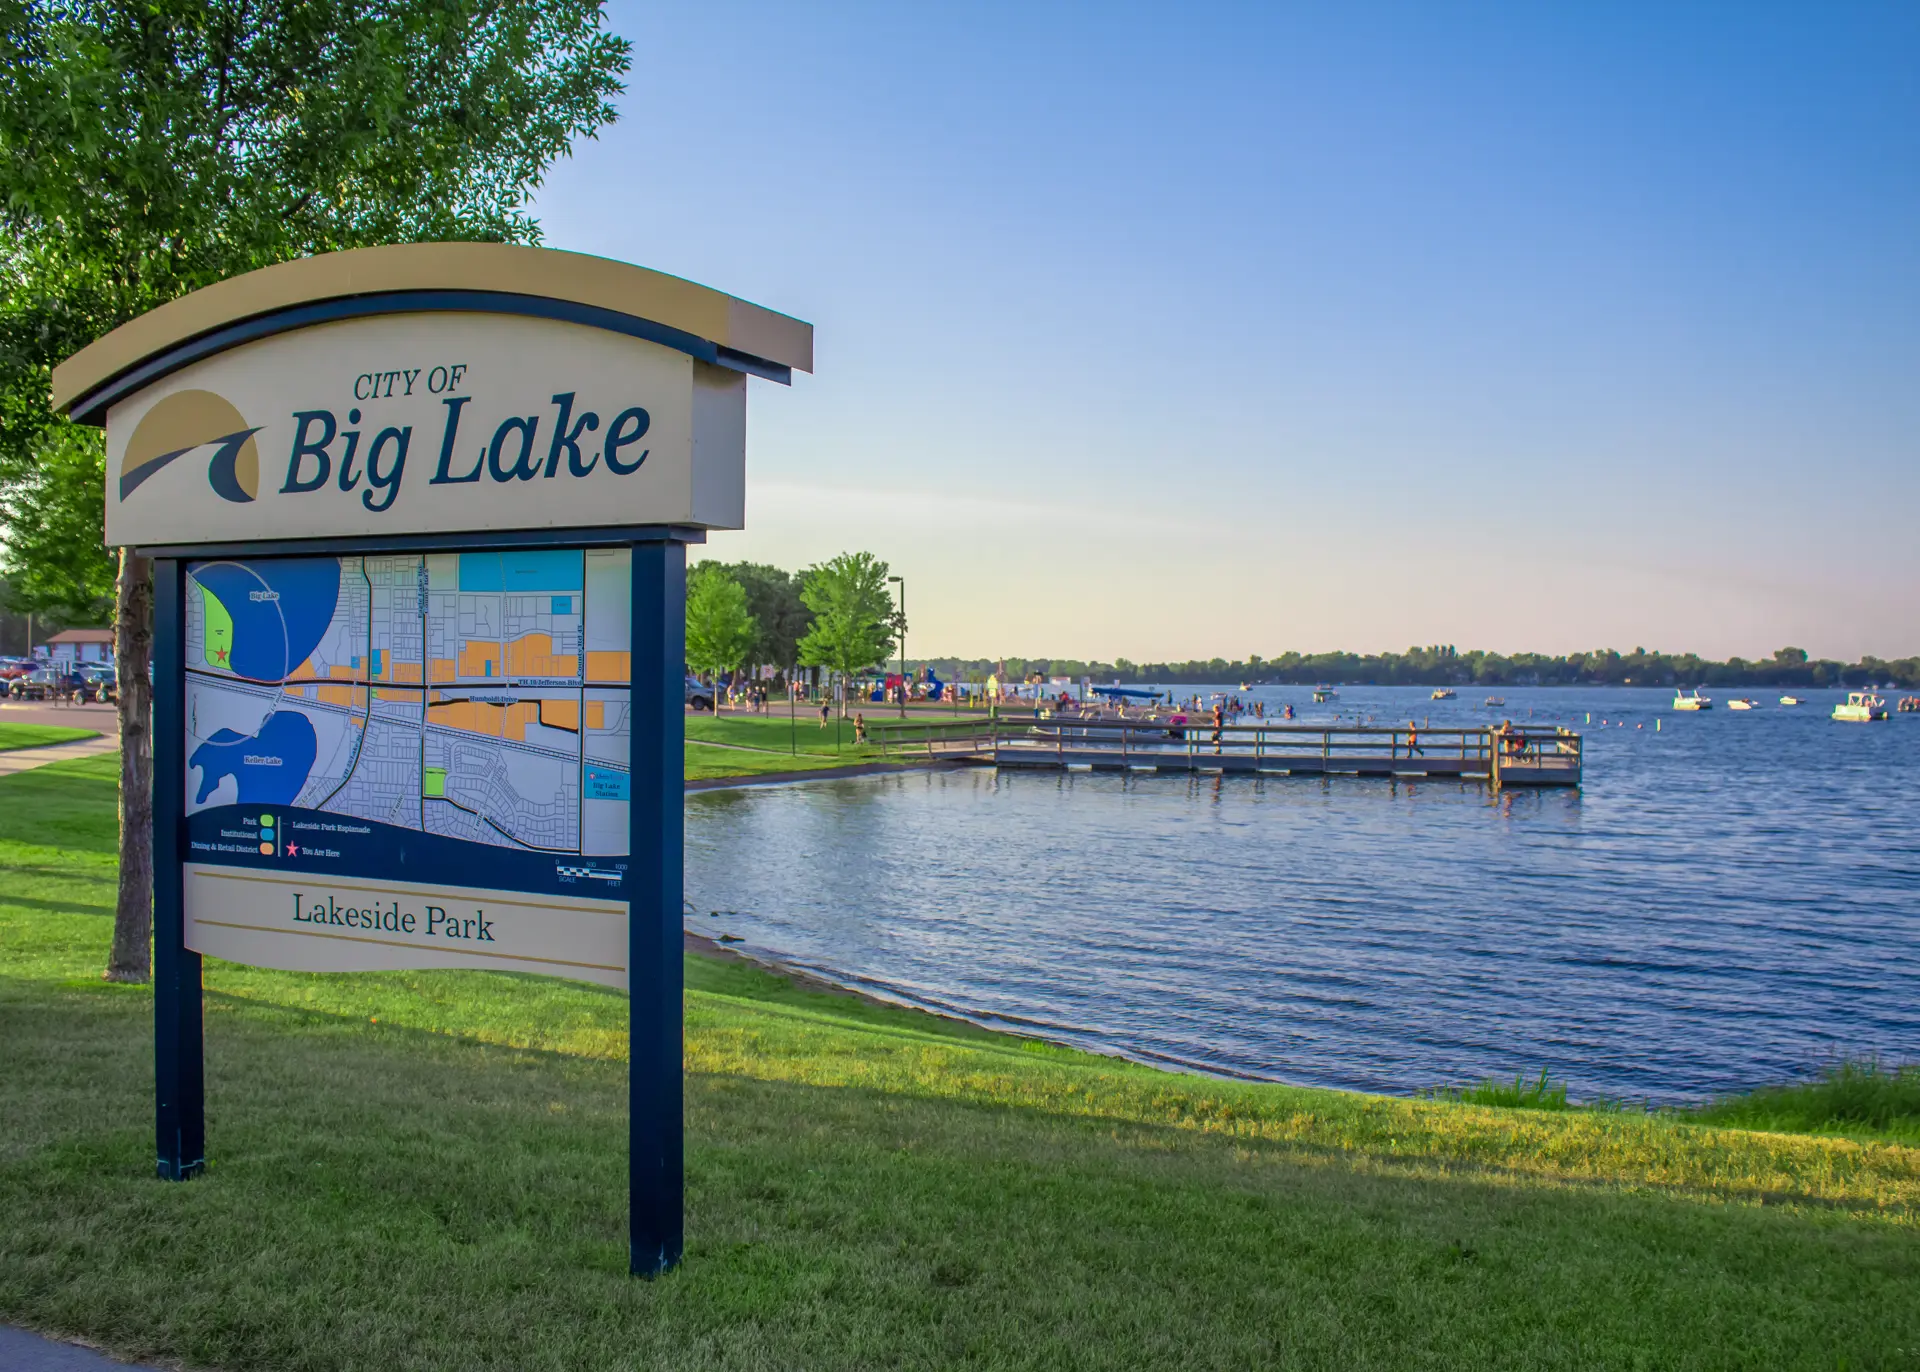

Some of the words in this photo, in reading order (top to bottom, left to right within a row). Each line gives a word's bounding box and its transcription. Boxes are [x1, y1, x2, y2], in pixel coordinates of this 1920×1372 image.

[354, 369, 420, 401] CITY
[428, 364, 468, 394] OF
[278, 408, 412, 512] Big
[429, 391, 651, 485] Lake
[250, 592, 261, 601] Big
[262, 592, 279, 600] Lake
[245, 756, 265, 764] Keller
[266, 757, 282, 765] Lake
[243, 817, 257, 826] Park
[292, 821, 319, 830] Lakeside
[321, 823, 336, 831] Park
[337, 824, 371, 834] Esplanade
[221, 829, 257, 839] Institutional
[191, 841, 210, 851] Dining
[217, 843, 235, 852] Retail
[236, 844, 258, 853] District
[302, 847, 313, 856] You
[314, 848, 325, 856] Are
[325, 849, 340, 858] Here
[293, 893, 416, 933] Lakeside
[425, 905, 496, 942] Park
